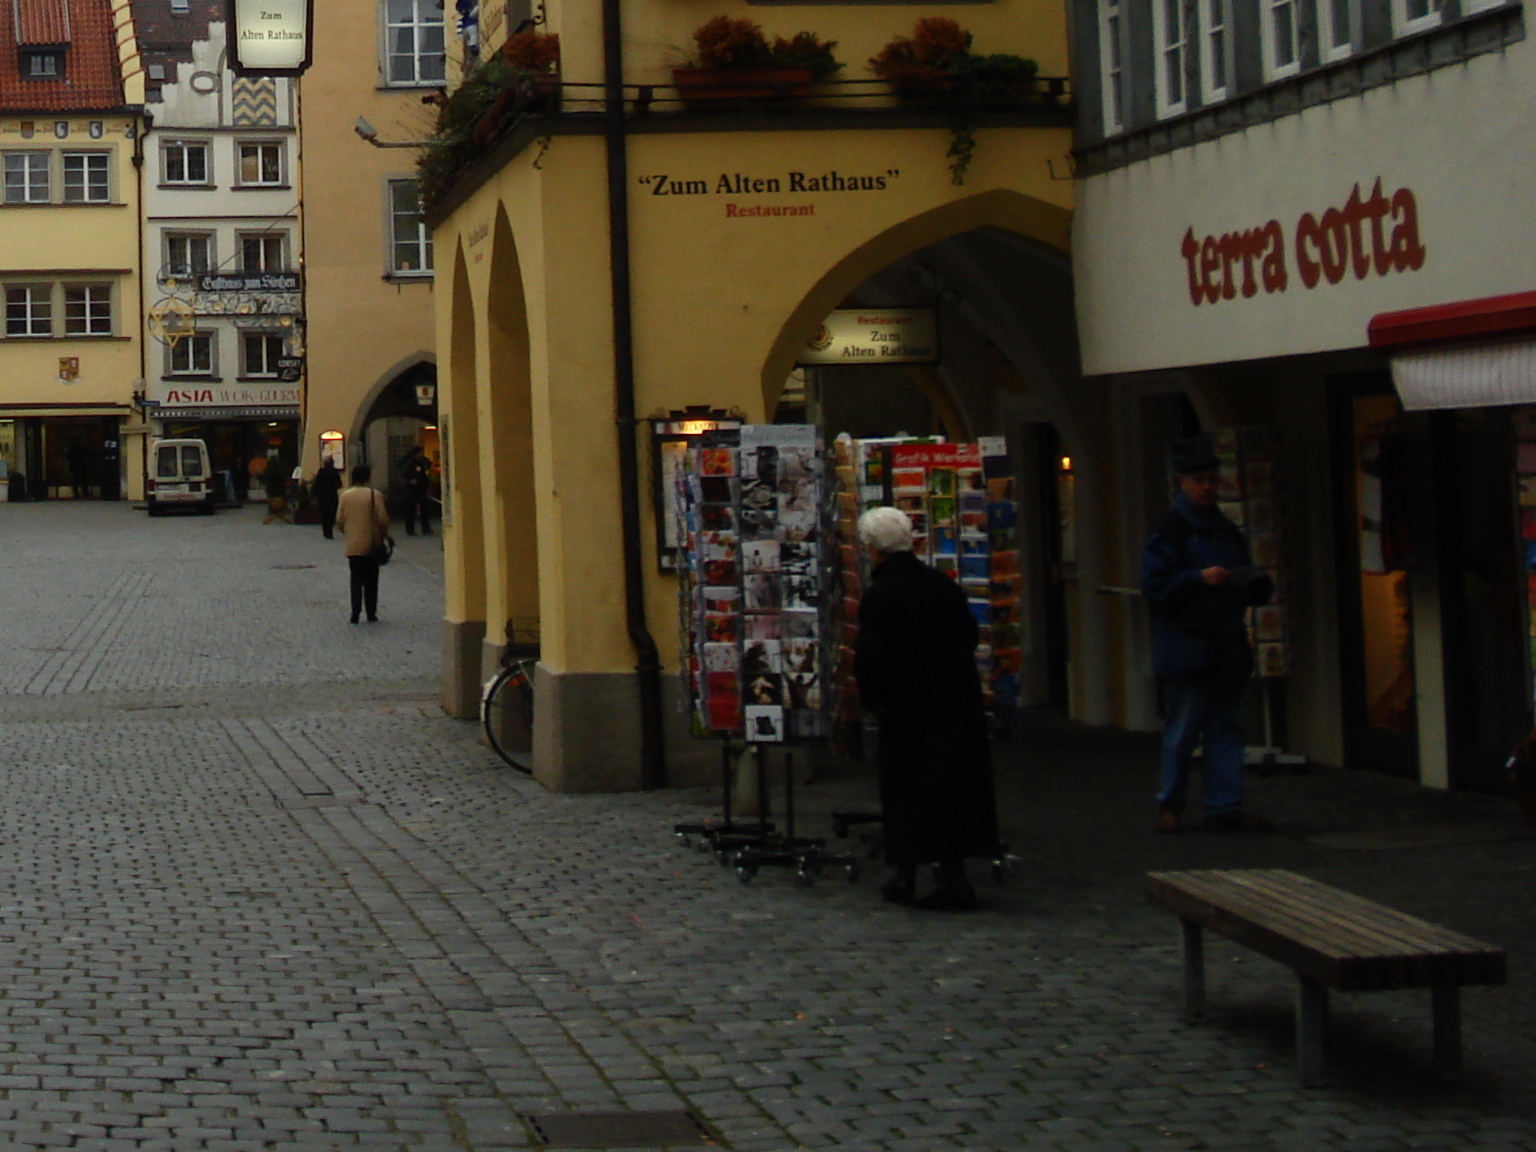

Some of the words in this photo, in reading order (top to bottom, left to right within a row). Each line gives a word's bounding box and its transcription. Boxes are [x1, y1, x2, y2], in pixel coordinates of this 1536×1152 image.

[260, 11, 282, 20] Zum
[241, 29, 265, 40] Alten
[267, 29, 303, 40] Rathaus
[716, 172, 781, 194] Alten
[726, 203, 815, 218] Restaurant
[1181, 225, 1288, 307] terra
[1296, 175, 1426, 290] cotta
[870, 330, 901, 342] Zum
[842, 346, 876, 357] Alten
[167, 390, 213, 403] ASIA
